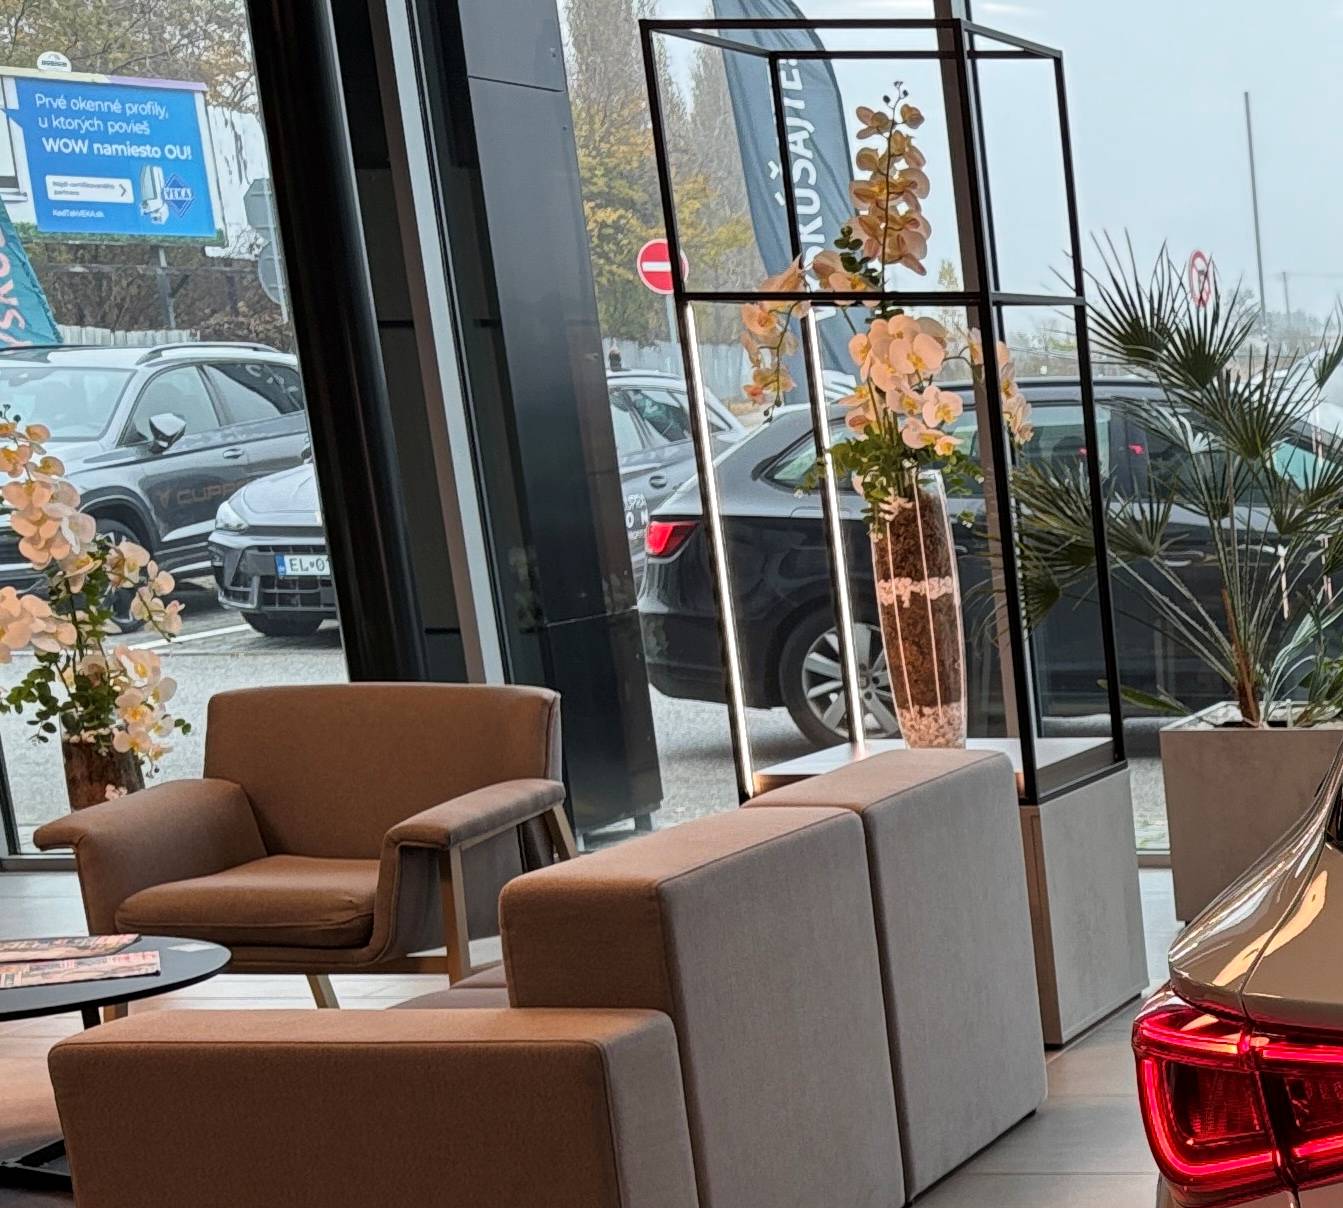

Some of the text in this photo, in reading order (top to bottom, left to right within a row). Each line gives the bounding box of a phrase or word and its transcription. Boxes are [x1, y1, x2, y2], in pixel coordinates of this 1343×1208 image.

[35, 93, 169, 120] Prvé okenné profily,
[38, 115, 151, 135] u ktorých povieš
[42, 137, 193, 160] WOW namiesto OU!
